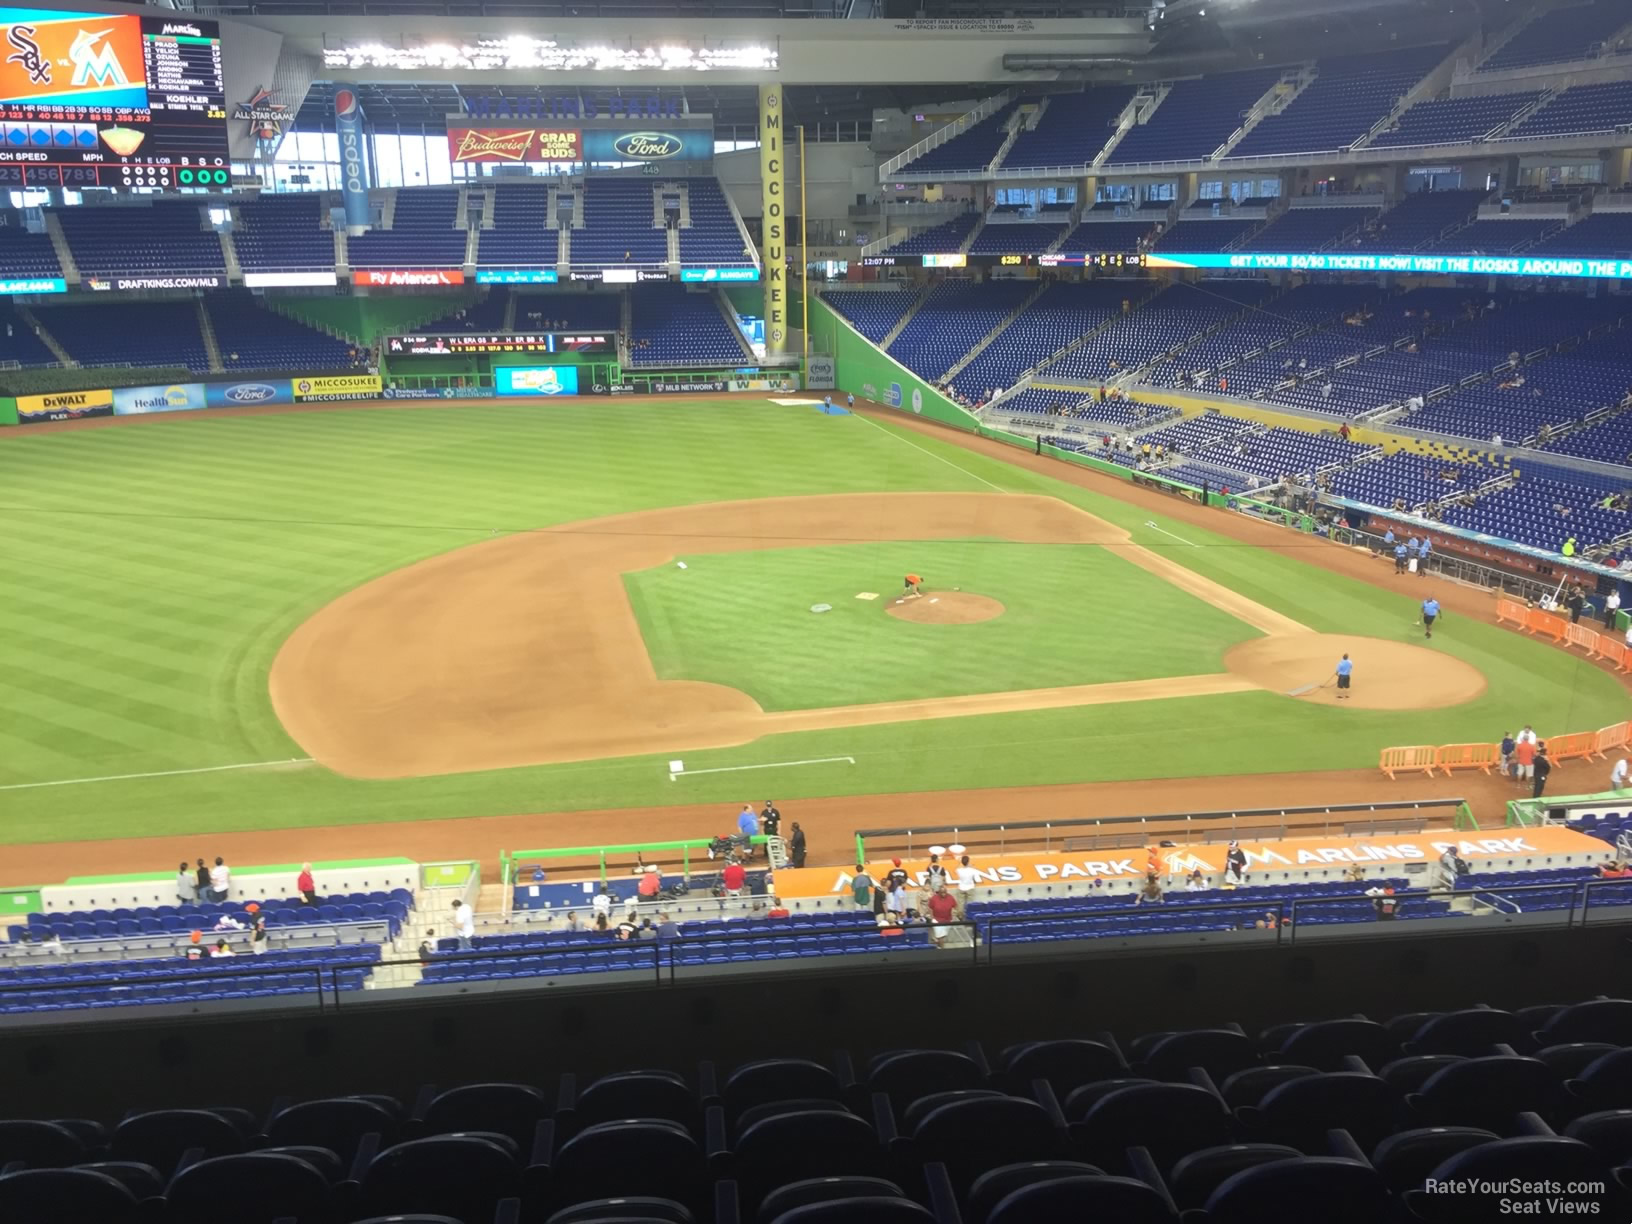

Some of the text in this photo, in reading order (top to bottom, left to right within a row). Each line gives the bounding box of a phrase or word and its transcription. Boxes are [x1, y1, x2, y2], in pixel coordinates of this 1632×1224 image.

[166, 95, 208, 103] KOEHLER
[468, 97, 682, 118] MARLINS PARK
[234, 111, 294, 120] ALL STAR GAME
[539, 133, 576, 142] GRAB
[457, 138, 532, 152] Budweiser
[627, 136, 669, 155] Ford
[541, 149, 576, 158] BUDS
[181, 157, 189, 166] B
[199, 158, 207, 166] S
[341, 128, 364, 192] pepsi
[122, 166, 168, 175] 0 0 0 0
[123, 177, 169, 186] 0 0 0 0
[180, 170, 227, 184] 0 0 0
[766, 114, 782, 323] MICCOSUKEE
[1001, 256, 1021, 265] $250
[1230, 256, 1251, 267] GET
[1256, 256, 1288, 267] YOUR
[1292, 256, 1325, 268] 50/50
[1328, 257, 1375, 269] TICKETS
[1414, 258, 1444, 270] VISIT
[1446, 259, 1469, 271] THE
[1473, 260, 1519, 273] KIOSKS
[1522, 261, 1583, 274] AROUND
[1587, 262, 1616, 276] THE
[118, 278, 218, 289] DRAFTKINGS.COM/MLB
[370, 272, 438, 284] Fly Avianca
[314, 378, 377, 387] MICCOSUKEE
[235, 387, 266, 399] Ford
[302, 392, 378, 402] #MICCOSUKEELIFE
[134, 396, 188, 408] HealthSun
[1034, 858, 1144, 880] PARK
